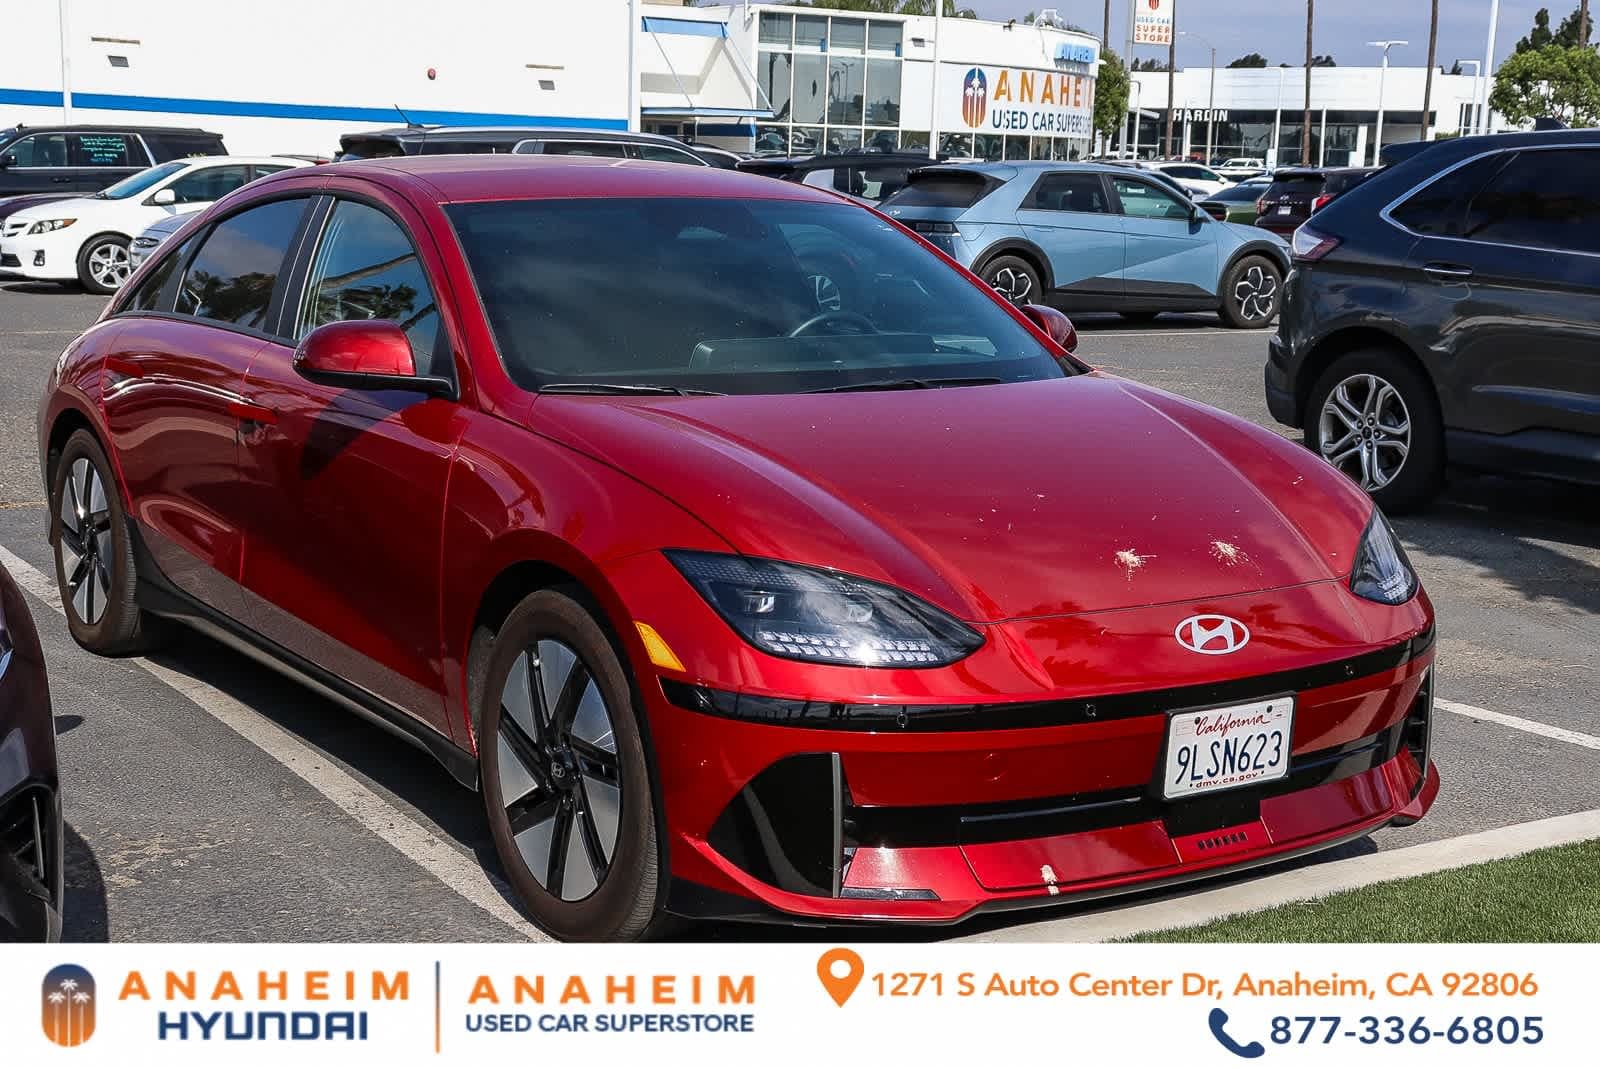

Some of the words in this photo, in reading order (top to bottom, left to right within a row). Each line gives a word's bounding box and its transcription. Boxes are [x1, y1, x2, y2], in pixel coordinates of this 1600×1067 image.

[1136, 24, 1170, 33] SUPER
[1136, 33, 1169, 42] STORE
[992, 109, 1028, 130] USED
[1032, 112, 1054, 131] CAR
[1173, 109, 1228, 122] HARDIN
[1196, 713, 1271, 737] California
[1175, 730, 1283, 785] 9LSN623
[1196, 773, 1258, 788] dmv.ca.gov
